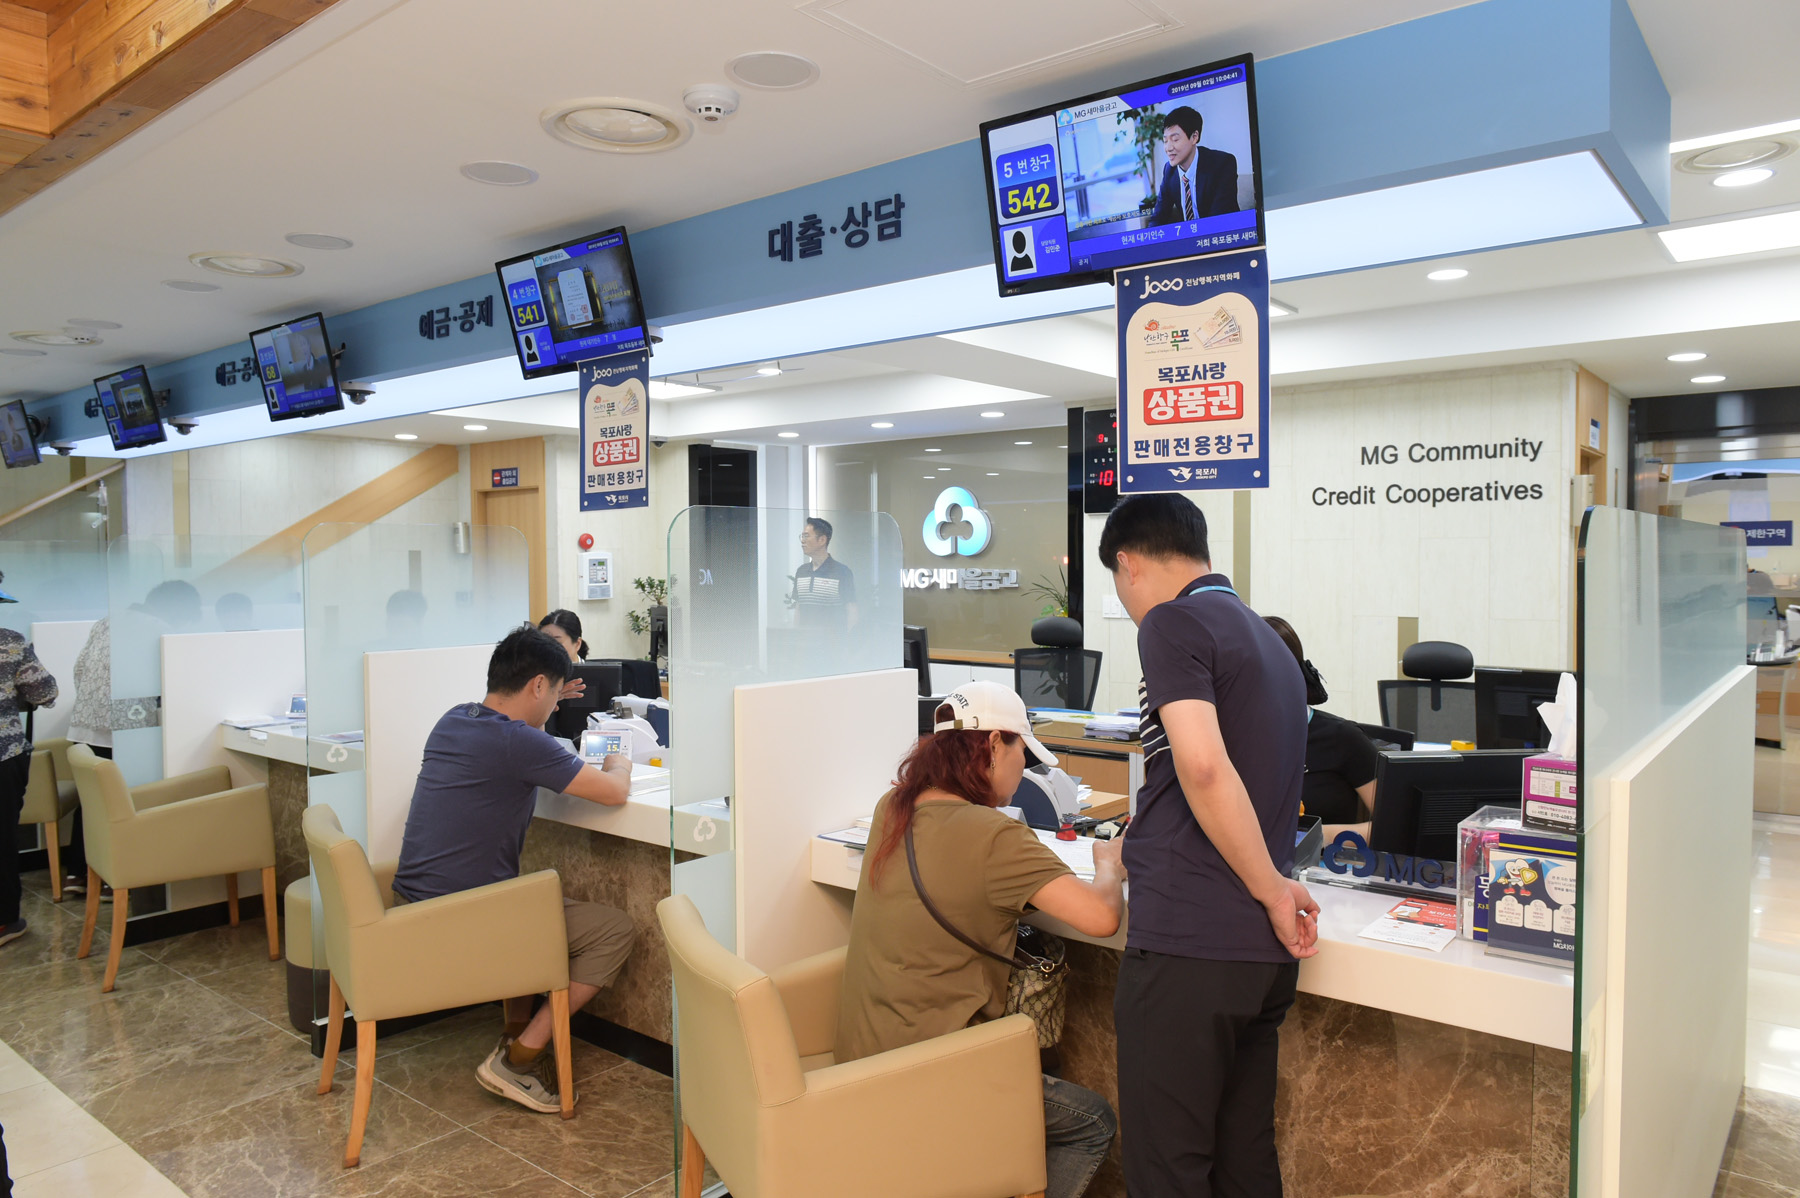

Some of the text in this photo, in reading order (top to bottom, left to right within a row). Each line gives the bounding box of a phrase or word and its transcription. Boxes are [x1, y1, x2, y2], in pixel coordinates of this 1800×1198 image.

[1171, 72, 1238, 94] 2019년 09월 02일 10:04:41
[1004, 162, 1013, 178] 5
[1008, 184, 1052, 214] 542
[768, 193, 905, 262] 대출·상담
[1121, 223, 1198, 246] 현재 대기인수 7 명
[1196, 237, 1211, 248] 저희
[1241, 230, 1258, 241] 새마
[512, 289, 519, 300] 4
[418, 294, 493, 340] 예금·공제
[517, 304, 540, 325] 541
[1158, 362, 1227, 384] 목포사랑
[1147, 383, 1237, 421] 상품권
[600, 424, 632, 439] 목포사랑
[595, 438, 637, 464] 상품권
[1134, 433, 1253, 459] 판매전용창구
[1361, 437, 1544, 465] MG Community
[588, 469, 643, 488] 판매전용창구
[1099, 470, 1114, 486] 10
[1312, 481, 1544, 508] Credit Cooperatives
[1746, 528, 1786, 538] 제한구역
[1384, 853, 1445, 889] MG
